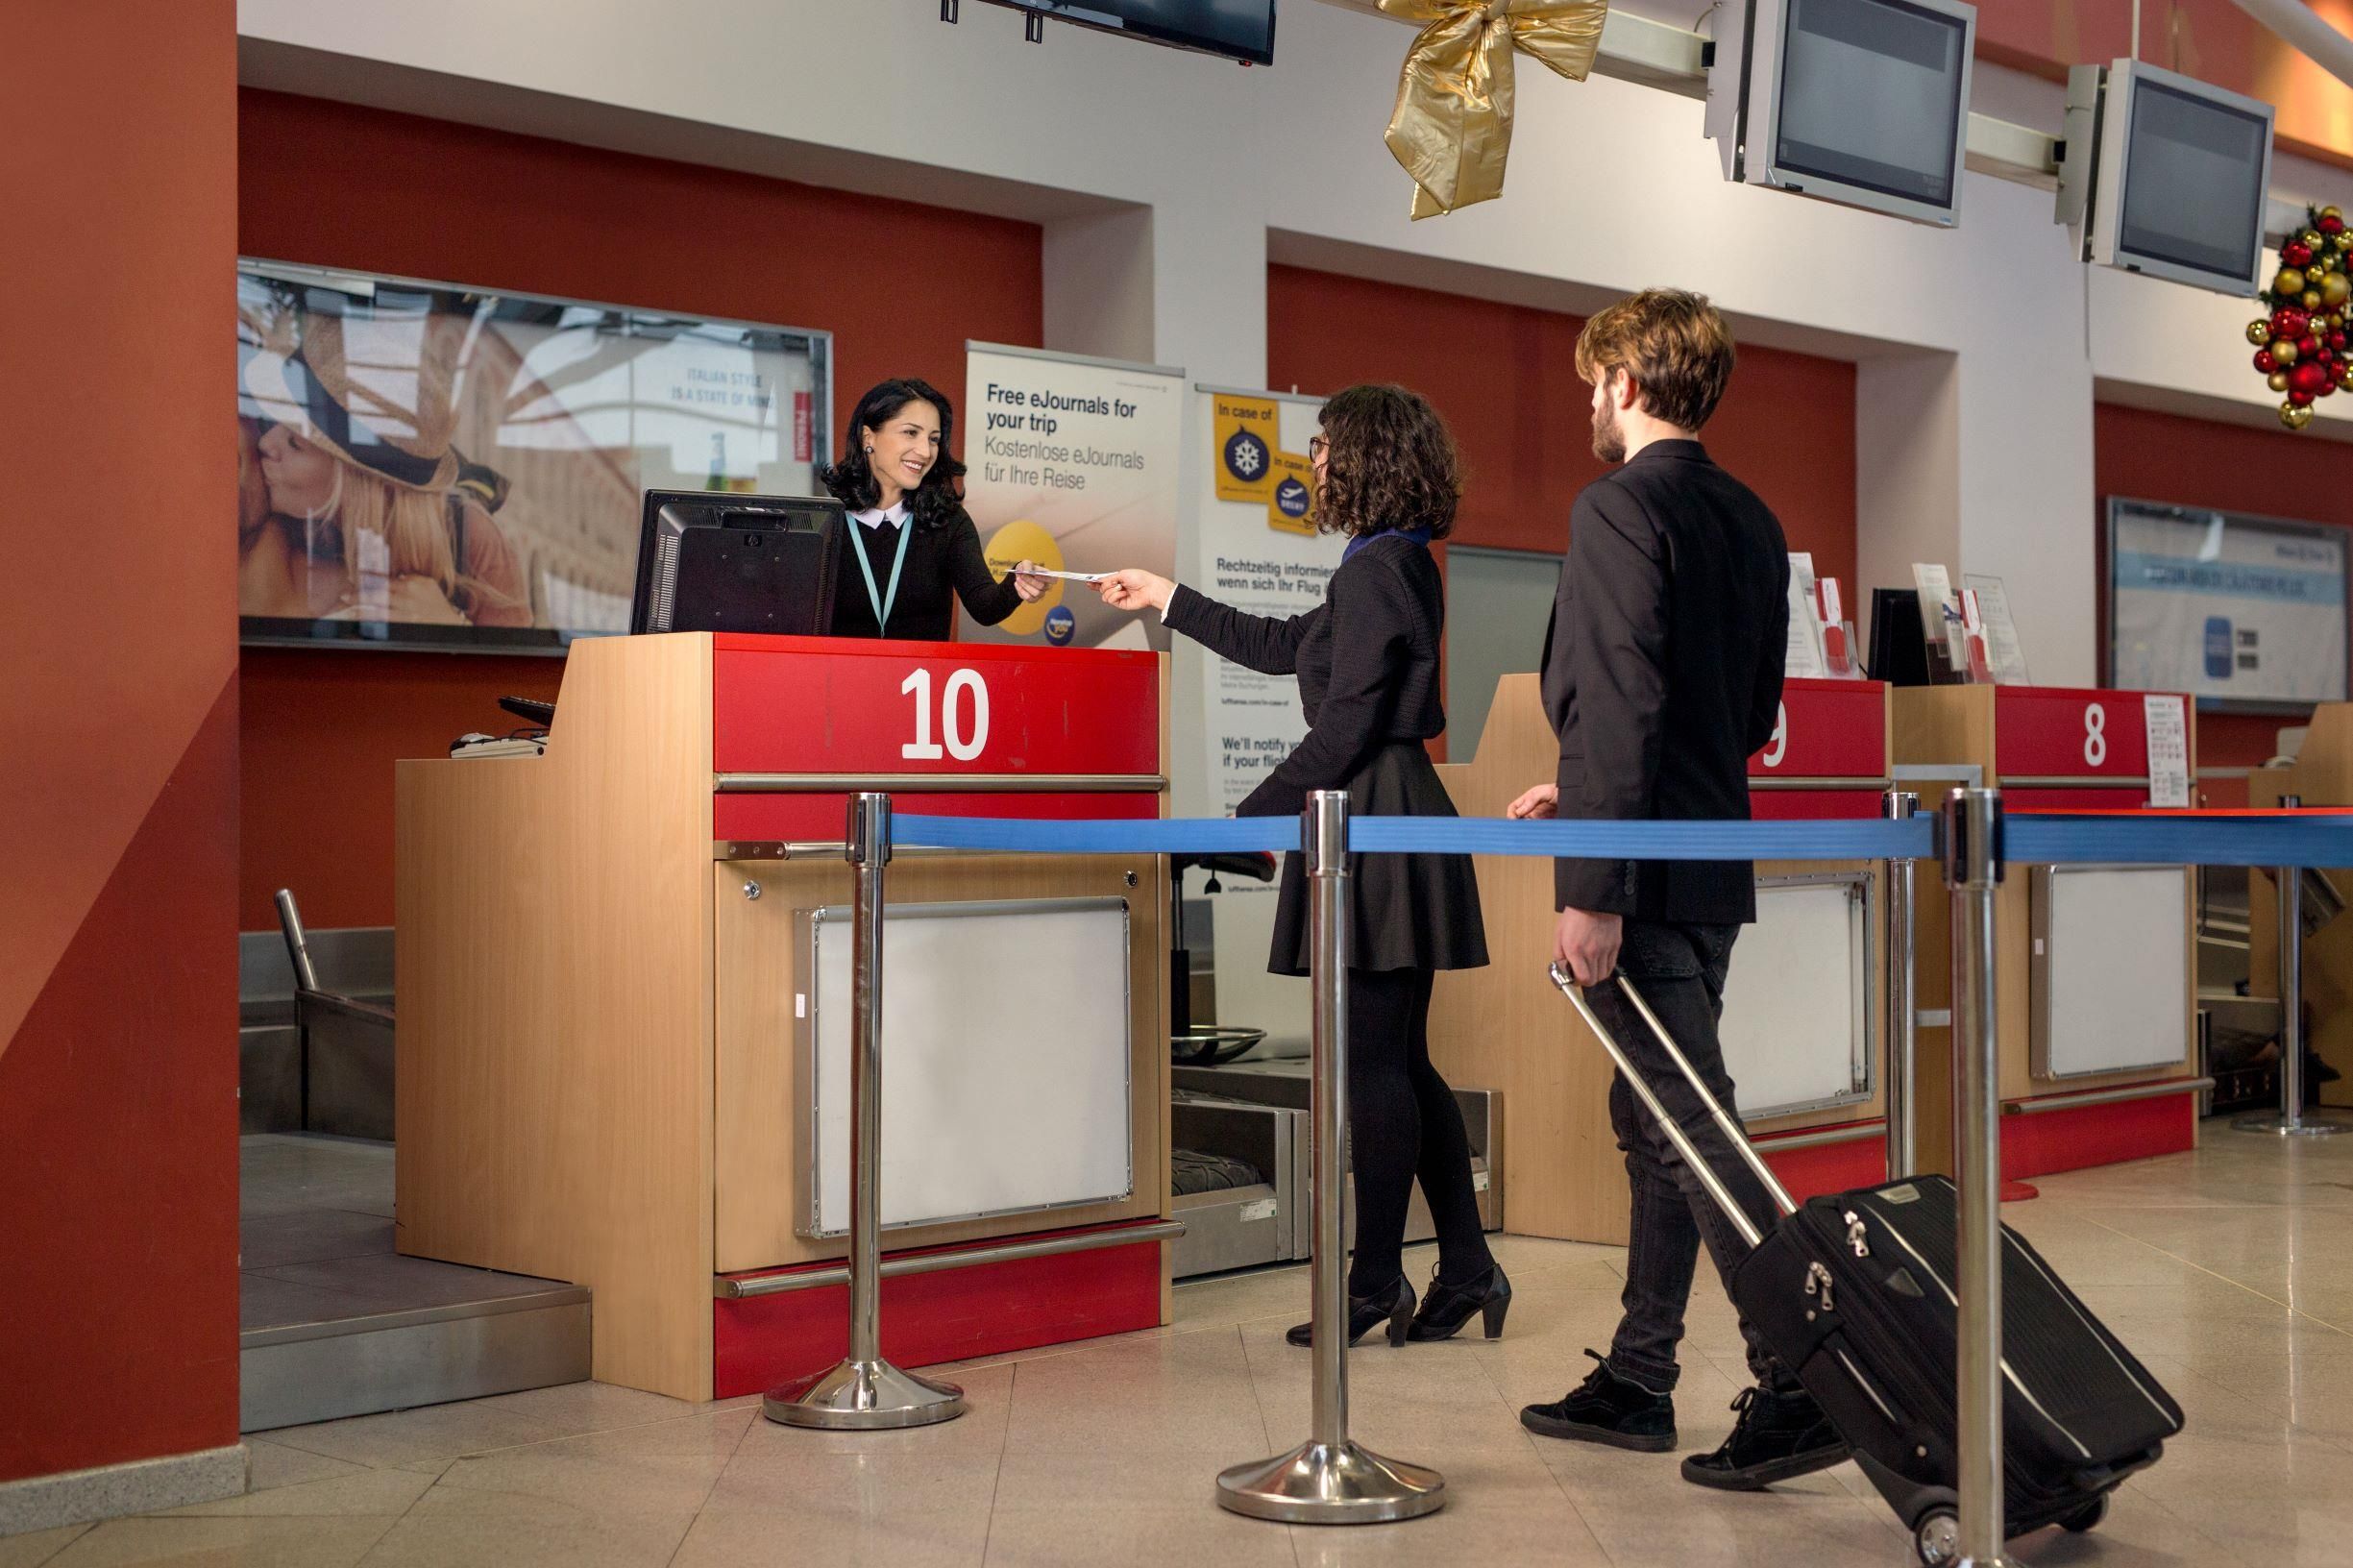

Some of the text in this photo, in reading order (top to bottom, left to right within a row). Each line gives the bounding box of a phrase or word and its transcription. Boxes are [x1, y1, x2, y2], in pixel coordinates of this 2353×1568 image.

[987, 383, 1137, 419] Free eJournals for
[1218, 404, 1272, 421] In case of
[987, 412, 1057, 436] your trip
[985, 435, 1144, 470] Kostenlose eJournals
[985, 461, 1086, 490] für Ihre Reise
[1216, 557, 1336, 578] Rechtzeitig informier
[1216, 577, 1248, 589] wenn
[1252, 576, 1275, 591] sich
[1278, 578, 1293, 592] Ihr
[1296, 579, 1321, 597] Flug
[901, 668, 990, 761] 10
[1254, 738, 1286, 753] notify
[2084, 702, 2106, 767] 8
[1223, 753, 1231, 767] if
[1234, 757, 1260, 770] your
